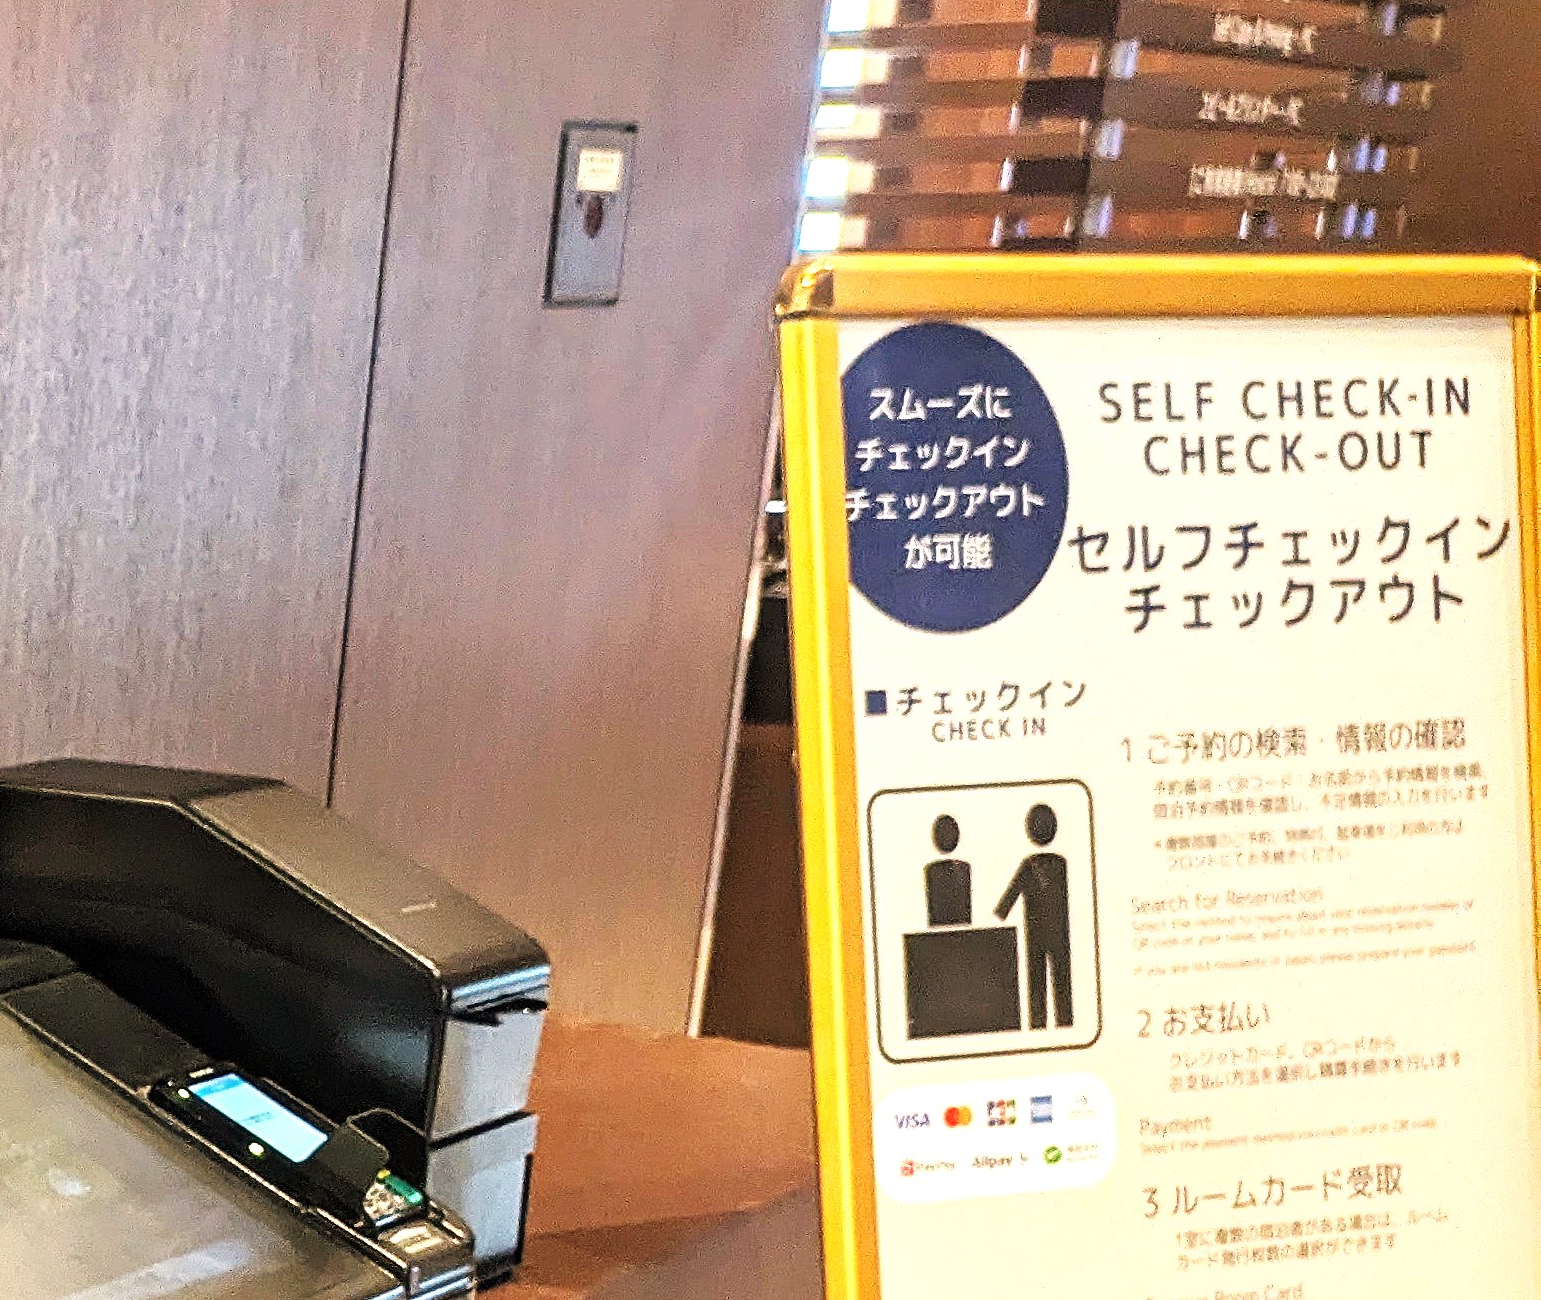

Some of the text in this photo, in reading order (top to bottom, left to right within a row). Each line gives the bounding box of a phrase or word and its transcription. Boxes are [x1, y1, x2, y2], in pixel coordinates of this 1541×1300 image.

[868, 386, 1012, 423] スムーズに
[1099, 375, 1472, 424] SELF CHECK-IN
[855, 437, 1032, 474] チェックイン
[1142, 428, 1434, 478] CHECK-OUT
[844, 486, 1045, 524] チェックアウト
[903, 532, 995, 572] が可能
[1067, 514, 1511, 576] セルフチェックイン
[1124, 571, 1465, 635] チェックアウト
[896, 680, 1088, 718] チェックイン
[931, 716, 1048, 744] CHECK IN
[1163, 1001, 1270, 1037] お支払い
[1172, 1163, 1403, 1215] ルームカード受取
